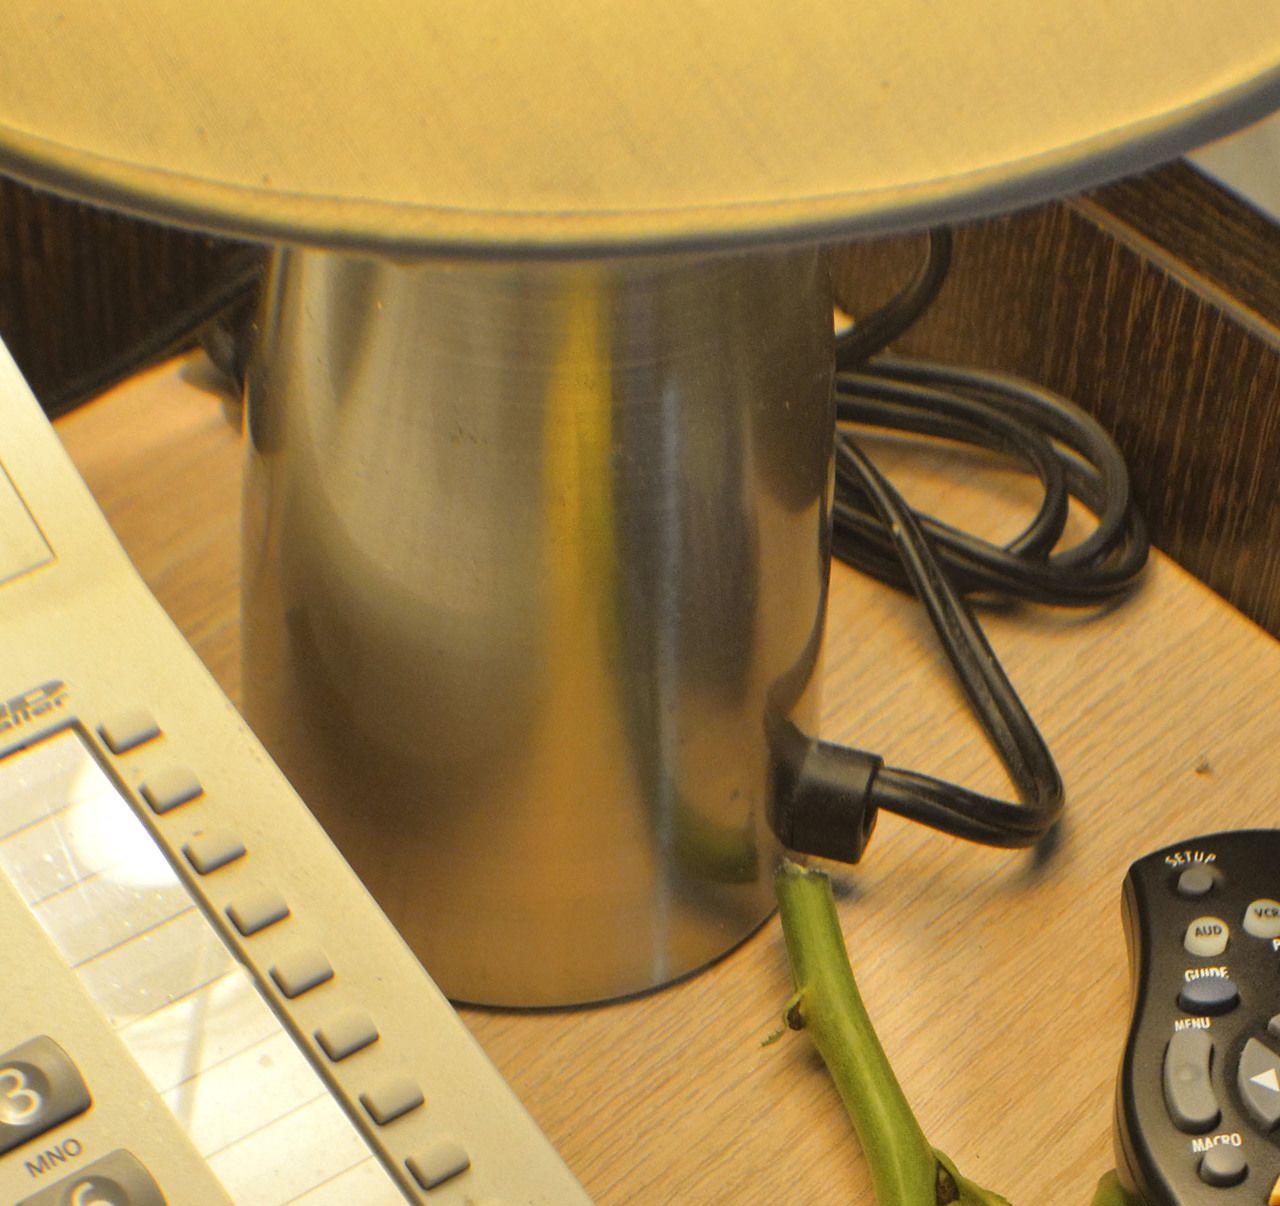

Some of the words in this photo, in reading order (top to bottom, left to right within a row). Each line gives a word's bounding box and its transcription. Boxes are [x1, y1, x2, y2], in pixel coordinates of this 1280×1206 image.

[1165, 851, 1217, 867] SETUP
[1254, 908, 1280, 919] VCR
[1195, 925, 1223, 937] AUD
[1174, 1017, 1211, 1032] MENU
[1192, 1133, 1242, 1153] MACRO
[25, 1137, 84, 1179] MNO
